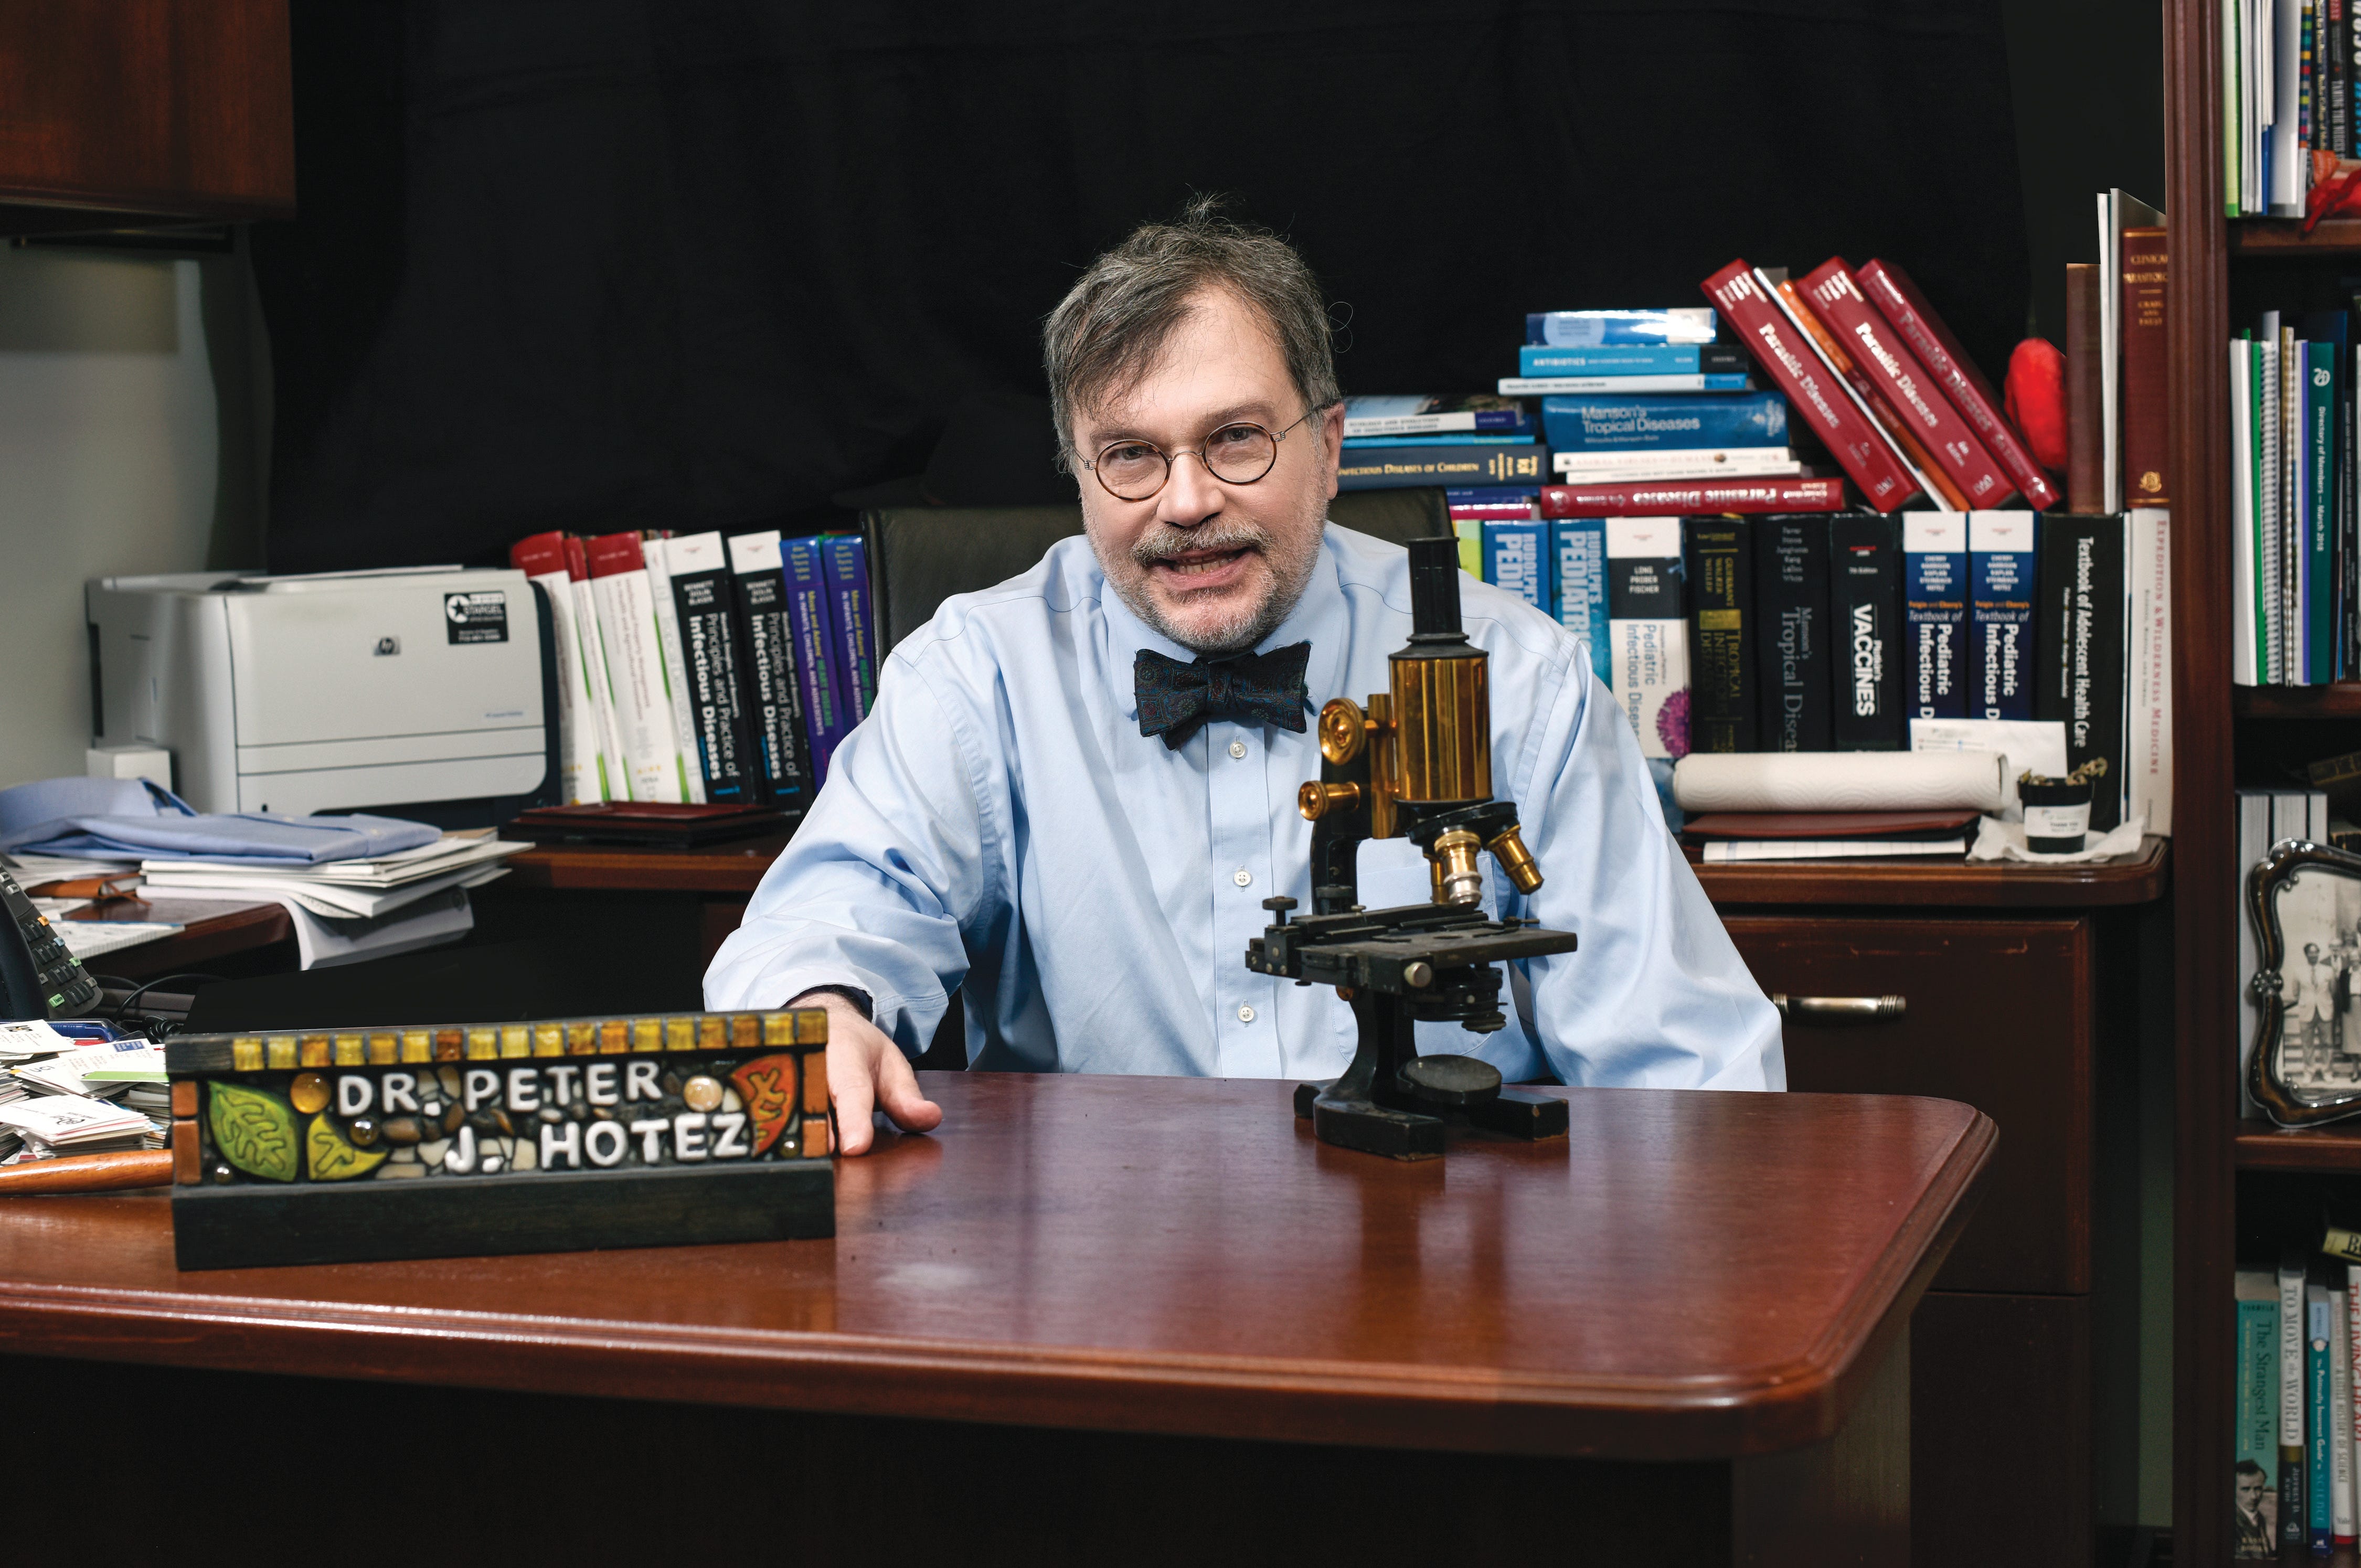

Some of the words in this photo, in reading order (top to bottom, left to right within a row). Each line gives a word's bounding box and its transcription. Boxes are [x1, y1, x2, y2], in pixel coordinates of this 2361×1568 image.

[1759, 322, 1804, 379] Parasitic
[1800, 374, 1841, 429] Diseases
[1855, 321, 1901, 379] Parasitic
[1896, 374, 1939, 428] Diseases
[1899, 310, 1948, 374] Parasitic
[1945, 369, 1993, 432] Diseases
[1581, 404, 1647, 420] Manson's
[1583, 419, 1635, 435] Tropical
[1636, 417, 1701, 431] Diseases
[2316, 406, 2326, 445] Directory
[2317, 445, 2326, 455] of
[2316, 455, 2325, 494] Members
[1633, 490, 1701, 507] Diseases
[1705, 488, 1777, 504] Parasitic
[1587, 530, 1603, 604] RUDOLPH'S
[1630, 575, 1658, 584] PROBER
[1634, 566, 1653, 574] LONG
[2077, 536, 2094, 594] Textbook
[2154, 520, 2168, 601] EXPEDITION
[797, 591, 806, 601] IN
[841, 590, 849, 600] IN
[1629, 585, 1660, 594] FISCHER
[2077, 594, 2093, 610] of
[1801, 606, 1813, 660] Manson's
[1909, 610, 1950, 622] Textbook
[1951, 610, 1964, 622] of
[1975, 610, 2016, 622] Textbook
[2018, 610, 2030, 622] of
[705, 612, 725, 677] Principles
[767, 612, 786, 676] Principles
[1626, 624, 1640, 689] Infectious
[1643, 624, 1660, 686] Pediatric
[1777, 606, 1803, 688] Tropical
[1853, 603, 1876, 717] VACCINES
[1937, 623, 1953, 696] Pediatric
[2003, 623, 2019, 697] Pediatric
[2075, 610, 2093, 677] Adolescent
[2152, 617, 2164, 702] WILDERNESS
[816, 658, 828, 689] HEART
[859, 658, 871, 688] HEART
[1919, 623, 1935, 704] Infectious
[1985, 623, 2001, 705] Infectious
[688, 615, 712, 703] Infectious
[701, 706, 722, 781] Diseases
[714, 677, 731, 706] and
[751, 614, 773, 702] Infectious
[763, 705, 782, 780] Diseases
[774, 677, 791, 705] and
[2075, 678, 2091, 720] Health
[1920, 707, 1935, 719] D
[1985, 708, 2001, 720] D
[716, 706, 736, 760] Practice
[779, 706, 796, 760] Practice
[2073, 721, 2090, 748] Care
[2150, 707, 2162, 774] MEDICINE
[725, 761, 741, 777] of
[785, 761, 802, 777] of
[338, 1072, 441, 1117] DR.
[463, 1061, 663, 1113] PETER
[444, 1125, 504, 1174] J.
[540, 1112, 749, 1169] HOTEZ
[2283, 1285, 2299, 1308] TO
[2256, 1320, 2272, 1348] The
[2283, 1310, 2299, 1358] MOVE
[2251, 1351, 2272, 1420] Strangest
[2286, 1361, 2299, 1378] the
[2315, 1370, 2325, 1404] Politically
[2283, 1378, 2300, 1441] WORLD
[2316, 1405, 2325, 1438] Incorrect
[2336, 1404, 2347, 1436] HISTORY
[2254, 1421, 2270, 1451] Man
[2316, 1438, 2325, 1462] Guide
[2337, 1438, 2347, 1448] OF
[2337, 1452, 2348, 1482] SCIENCE
[2315, 1470, 2324, 1522] SCIENCE
